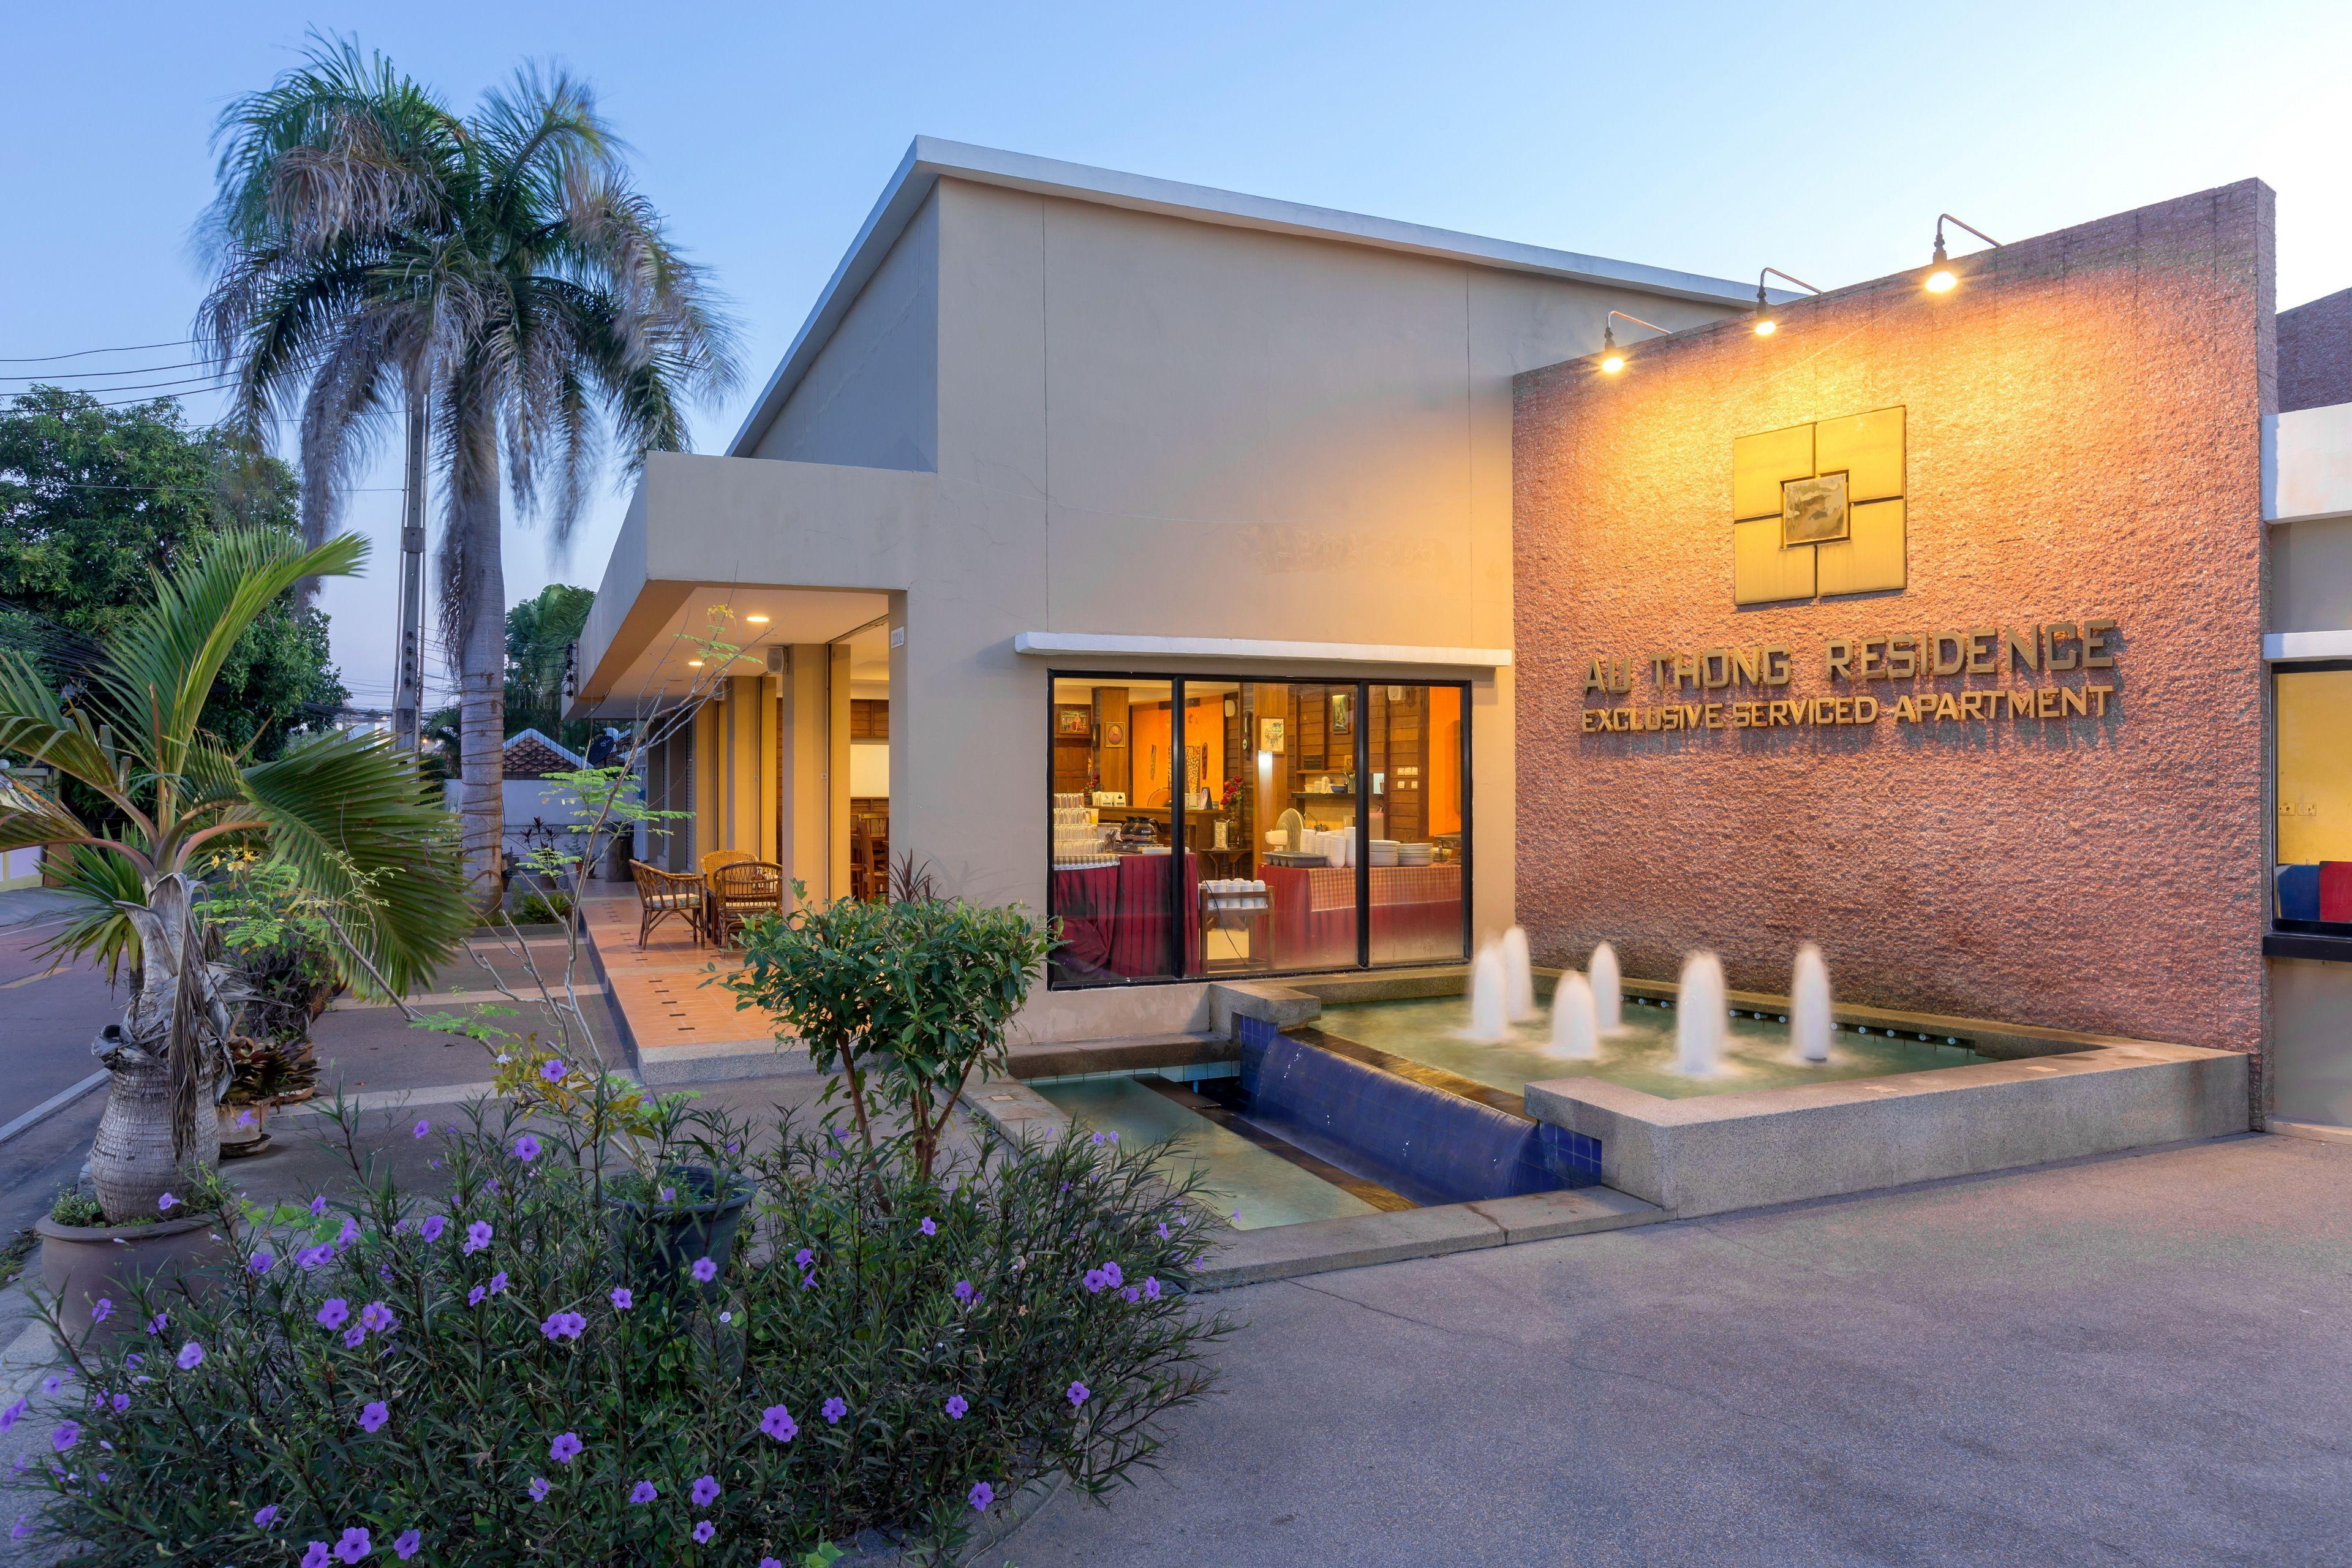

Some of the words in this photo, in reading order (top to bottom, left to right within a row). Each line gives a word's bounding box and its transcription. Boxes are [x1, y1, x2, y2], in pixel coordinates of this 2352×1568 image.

[1583, 657, 1631, 694] AU
[1648, 644, 1792, 692] THONG
[1826, 619, 2116, 681] RESIDENCE
[1582, 703, 1724, 733] EXCLUSIVE
[1732, 696, 1879, 728] SERVICED
[1893, 685, 2114, 723] APARTMENT
